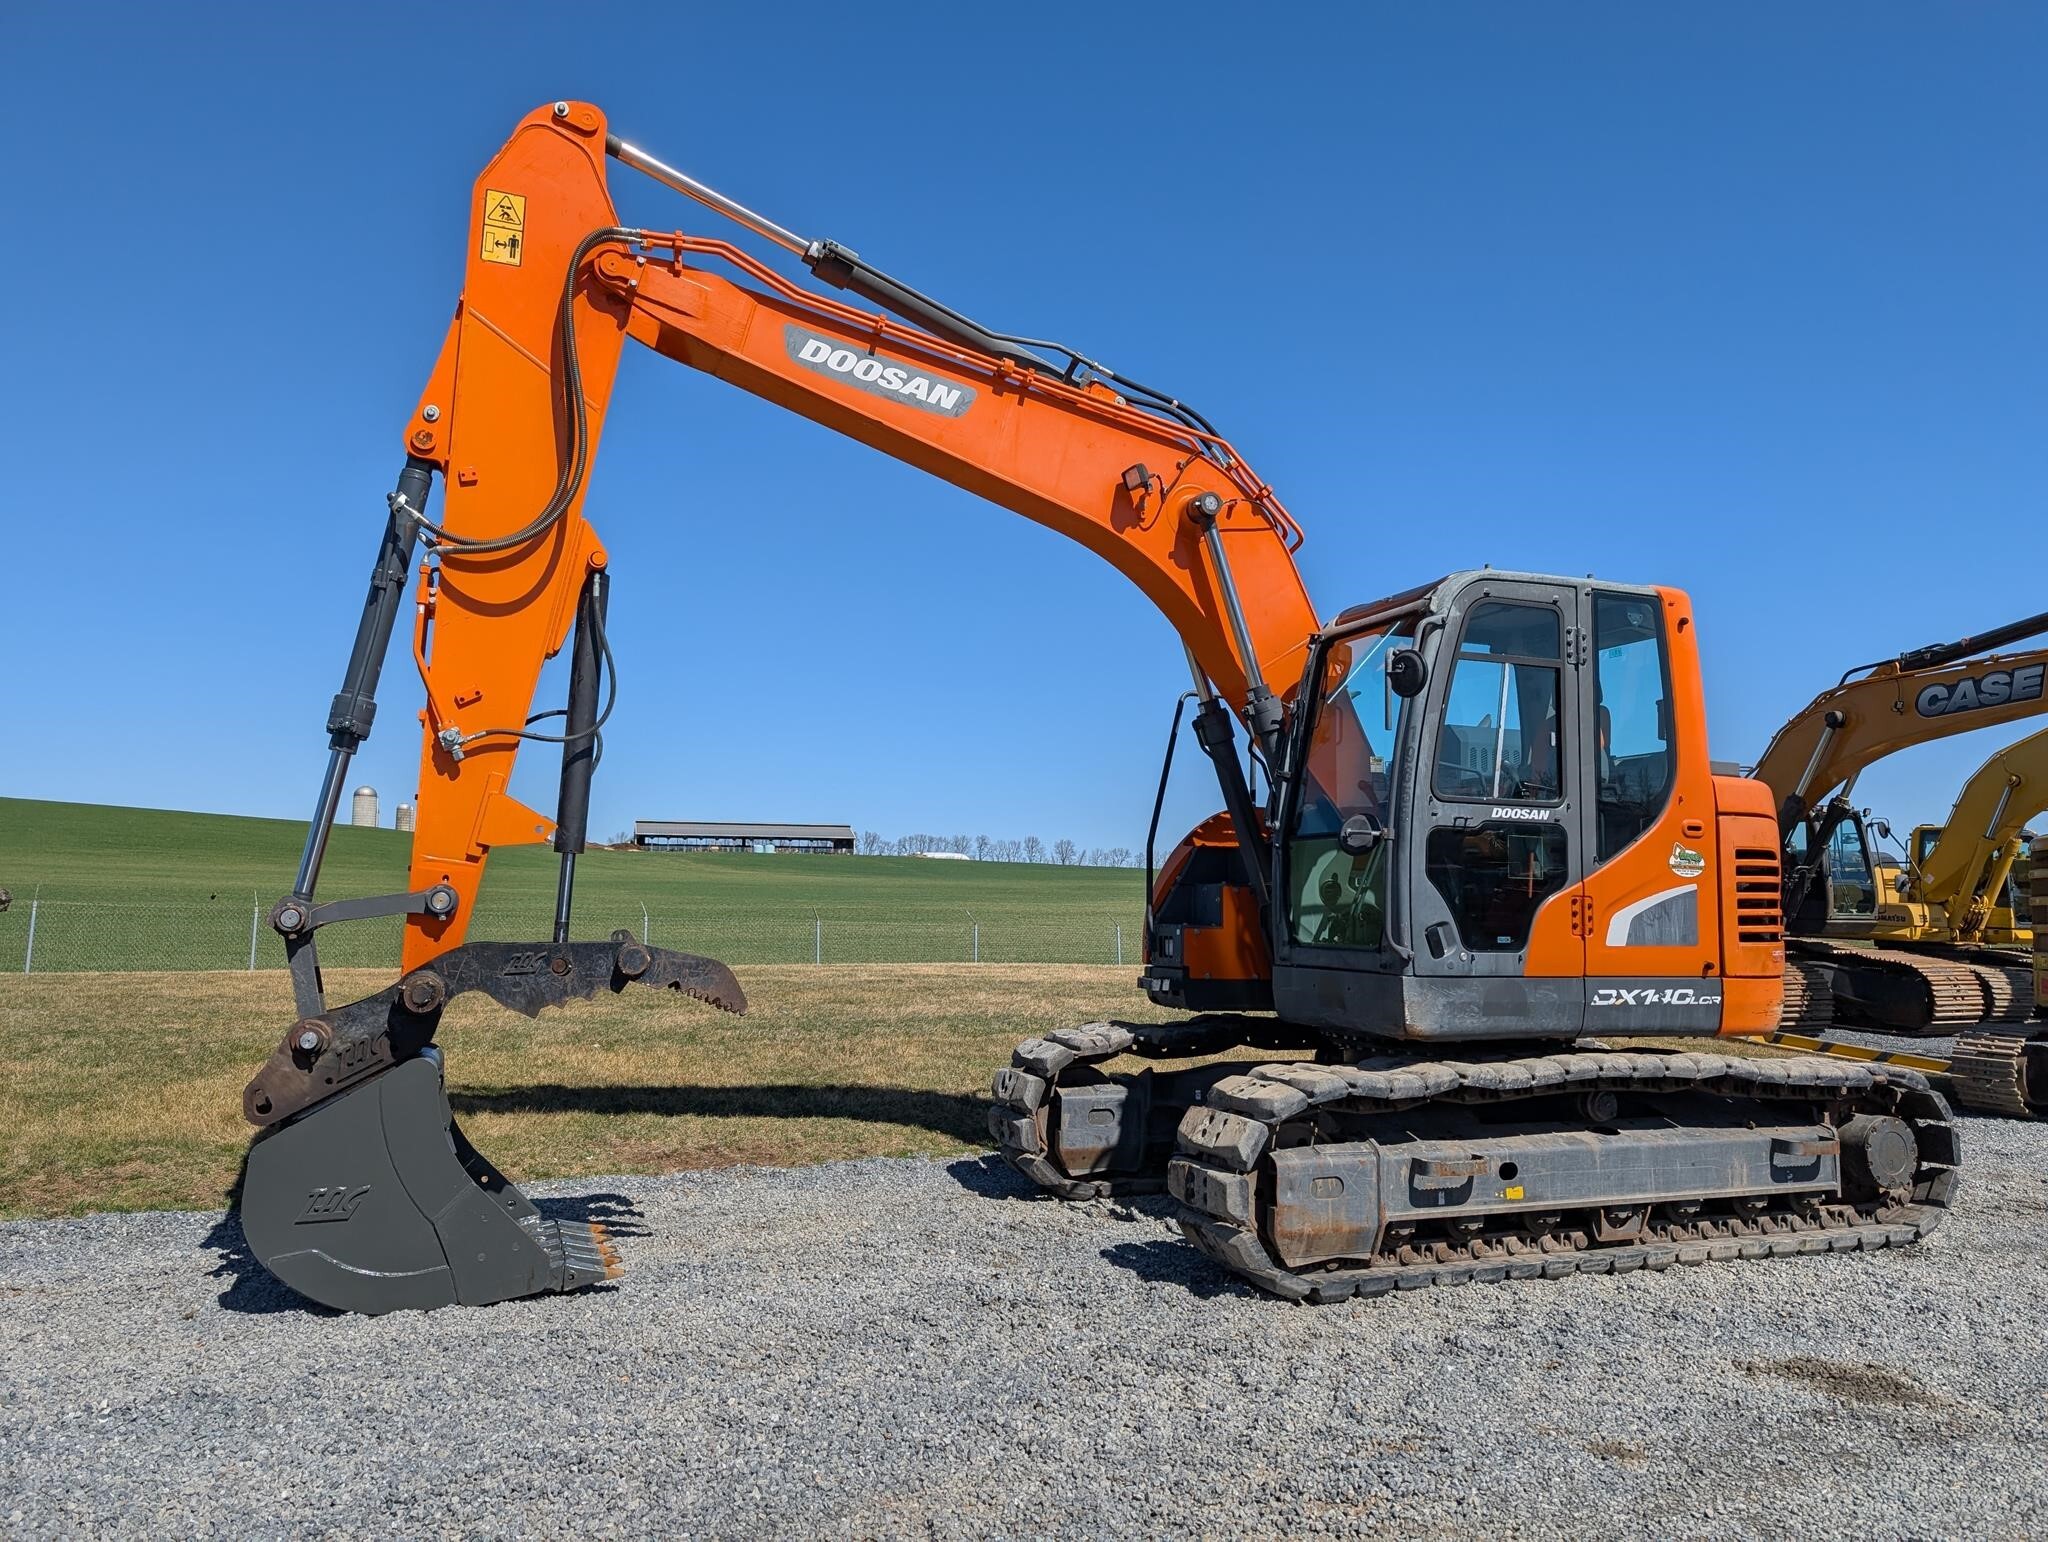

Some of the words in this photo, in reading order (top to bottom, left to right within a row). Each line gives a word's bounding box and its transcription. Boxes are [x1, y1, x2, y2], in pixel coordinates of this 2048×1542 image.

[798, 338, 962, 410] DOOSAN
[1916, 664, 2045, 718] CASE
[1491, 807, 1550, 820] DOOSAN
